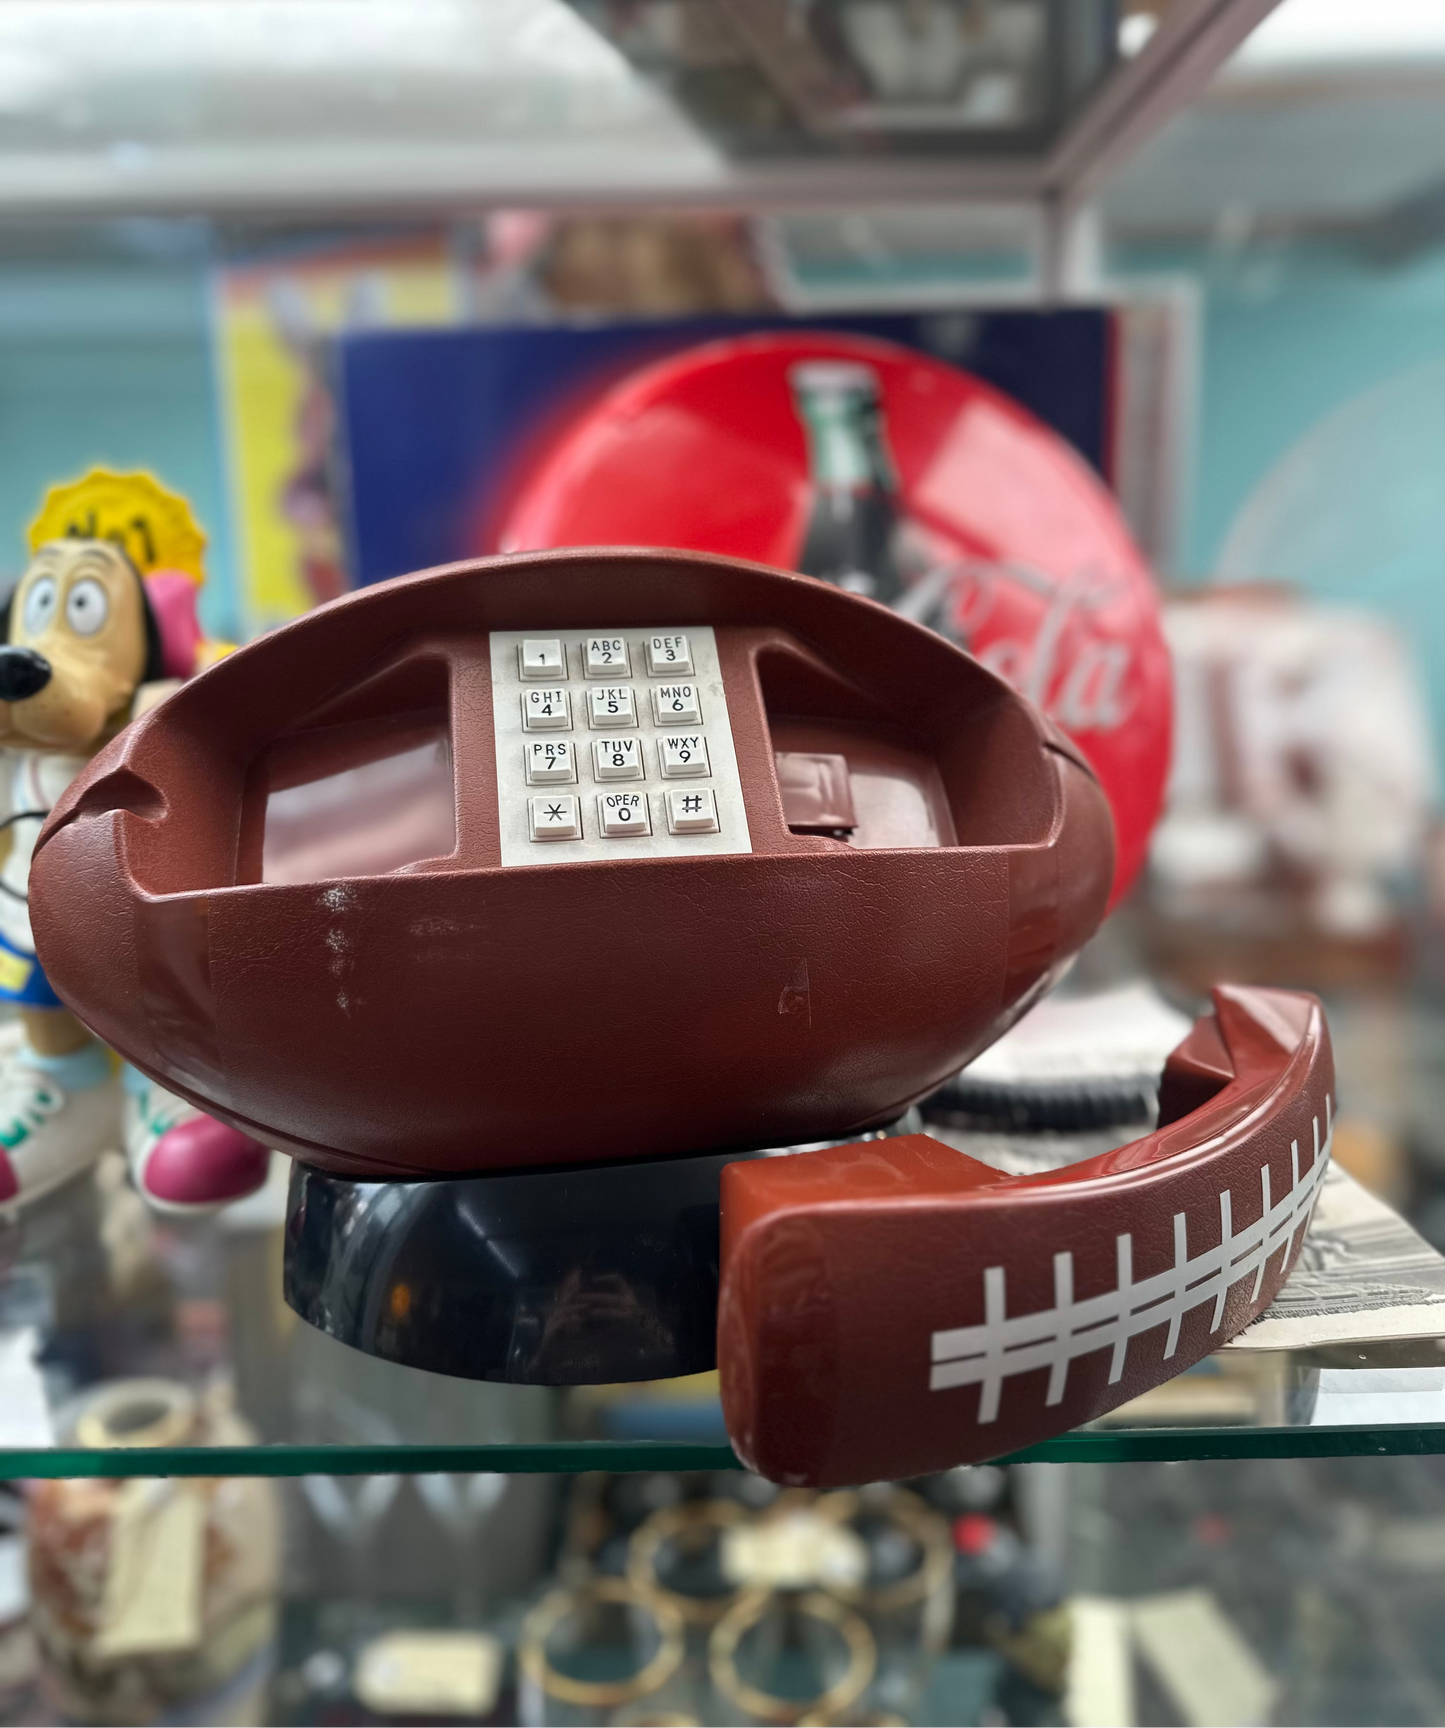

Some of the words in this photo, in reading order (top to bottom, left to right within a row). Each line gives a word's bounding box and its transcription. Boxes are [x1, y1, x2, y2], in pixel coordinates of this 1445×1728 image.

[591, 640, 621, 651] ABC
[653, 637, 682, 649] DEF
[538, 653, 546, 665] 1
[601, 652, 613, 664] 2
[665, 649, 676, 661] 3
[530, 691, 562, 703] GHI
[597, 688, 627, 700] JKL
[660, 686, 691, 698] MNO
[541, 704, 553, 716] 4
[607, 701, 619, 713] 5
[672, 699, 684, 711] 6
[602, 741, 632, 752] TUV
[668, 737, 699, 749] WXY
[534, 744, 566, 755] PRS
[612, 753, 625, 767] 8
[679, 750, 691, 763] 9
[545, 757, 557, 770] 7
[606, 794, 639, 807] OPER
